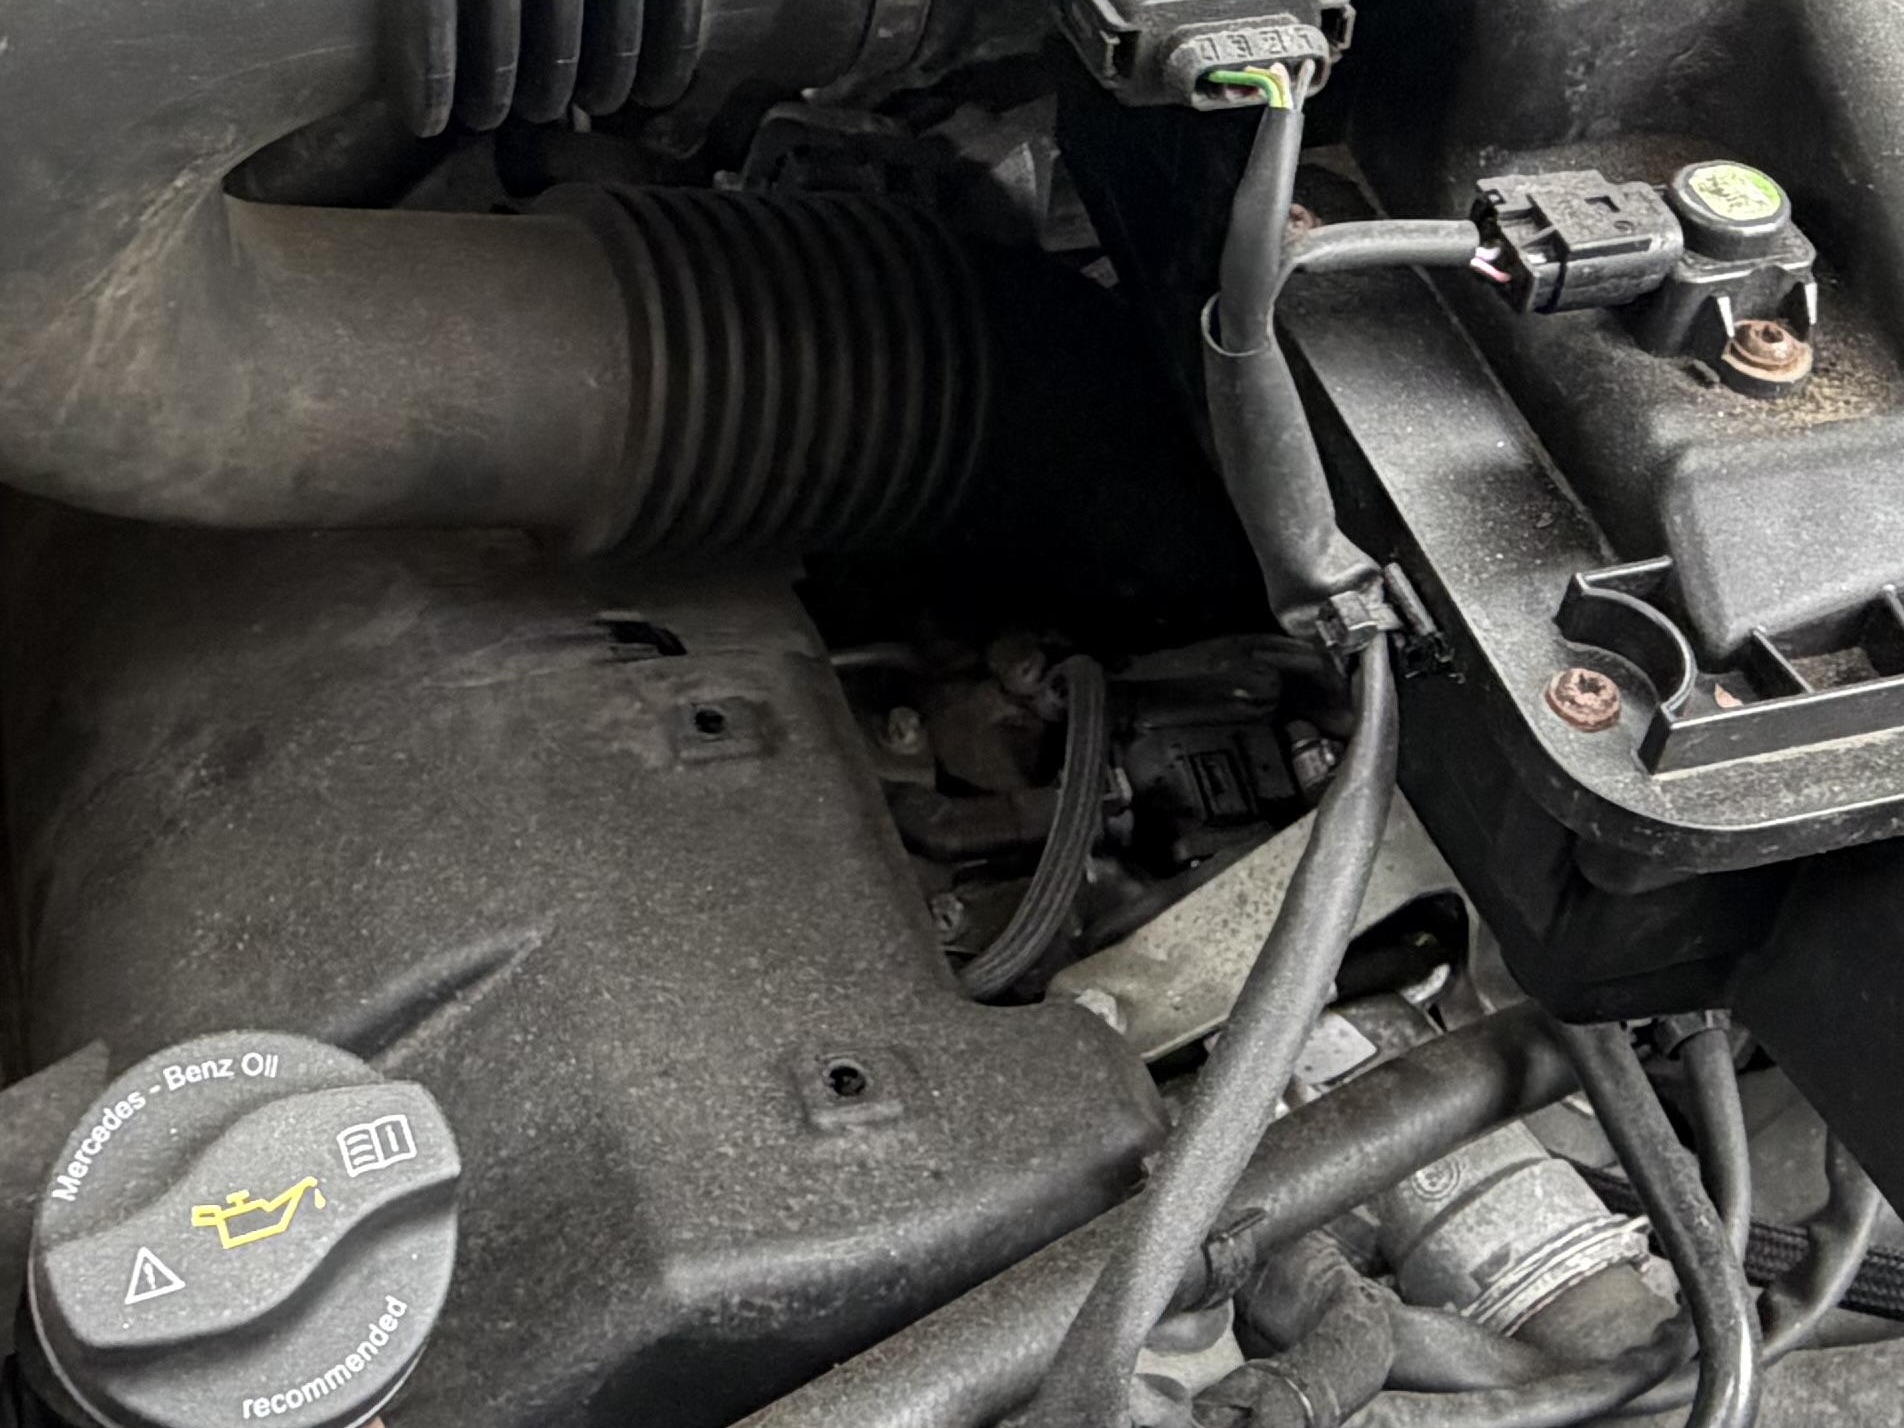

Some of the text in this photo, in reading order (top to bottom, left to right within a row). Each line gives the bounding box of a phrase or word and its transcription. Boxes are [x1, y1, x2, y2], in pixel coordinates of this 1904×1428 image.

[52, 1089, 146, 1201] Mercedes
[163, 1060, 234, 1090] Benz
[242, 1294, 408, 1418] recommended
